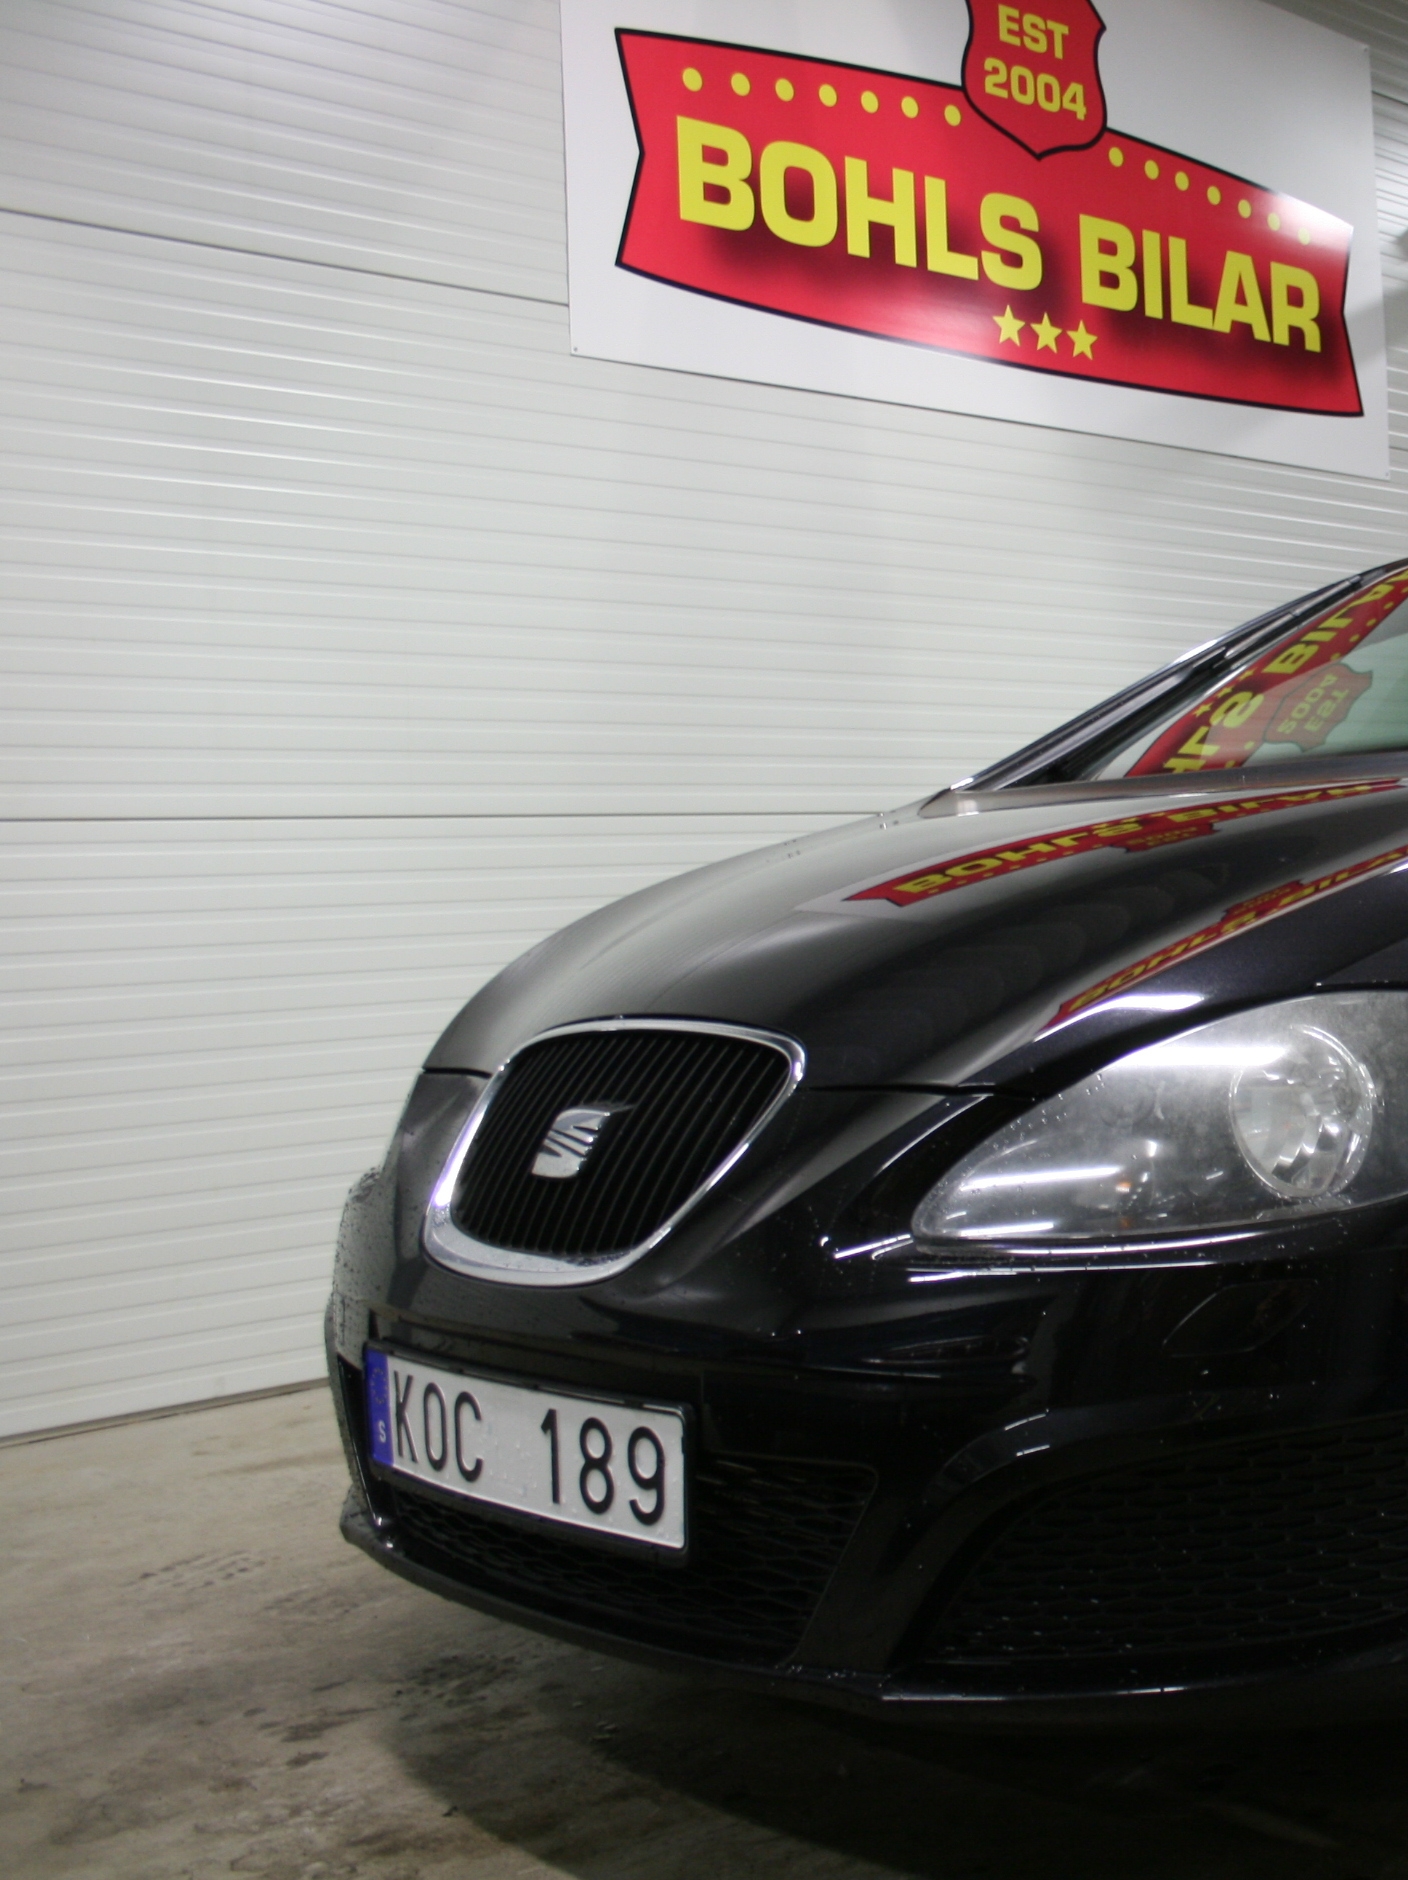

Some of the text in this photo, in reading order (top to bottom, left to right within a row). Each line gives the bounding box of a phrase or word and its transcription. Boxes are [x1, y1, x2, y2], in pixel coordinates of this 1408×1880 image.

[999, 5, 1068, 59] EST
[984, 58, 1086, 120] 2004
[676, 116, 1320, 352] BOHLS BILAR
[378, 1419, 387, 1444] S
[394, 1370, 666, 1526] KOC 189
